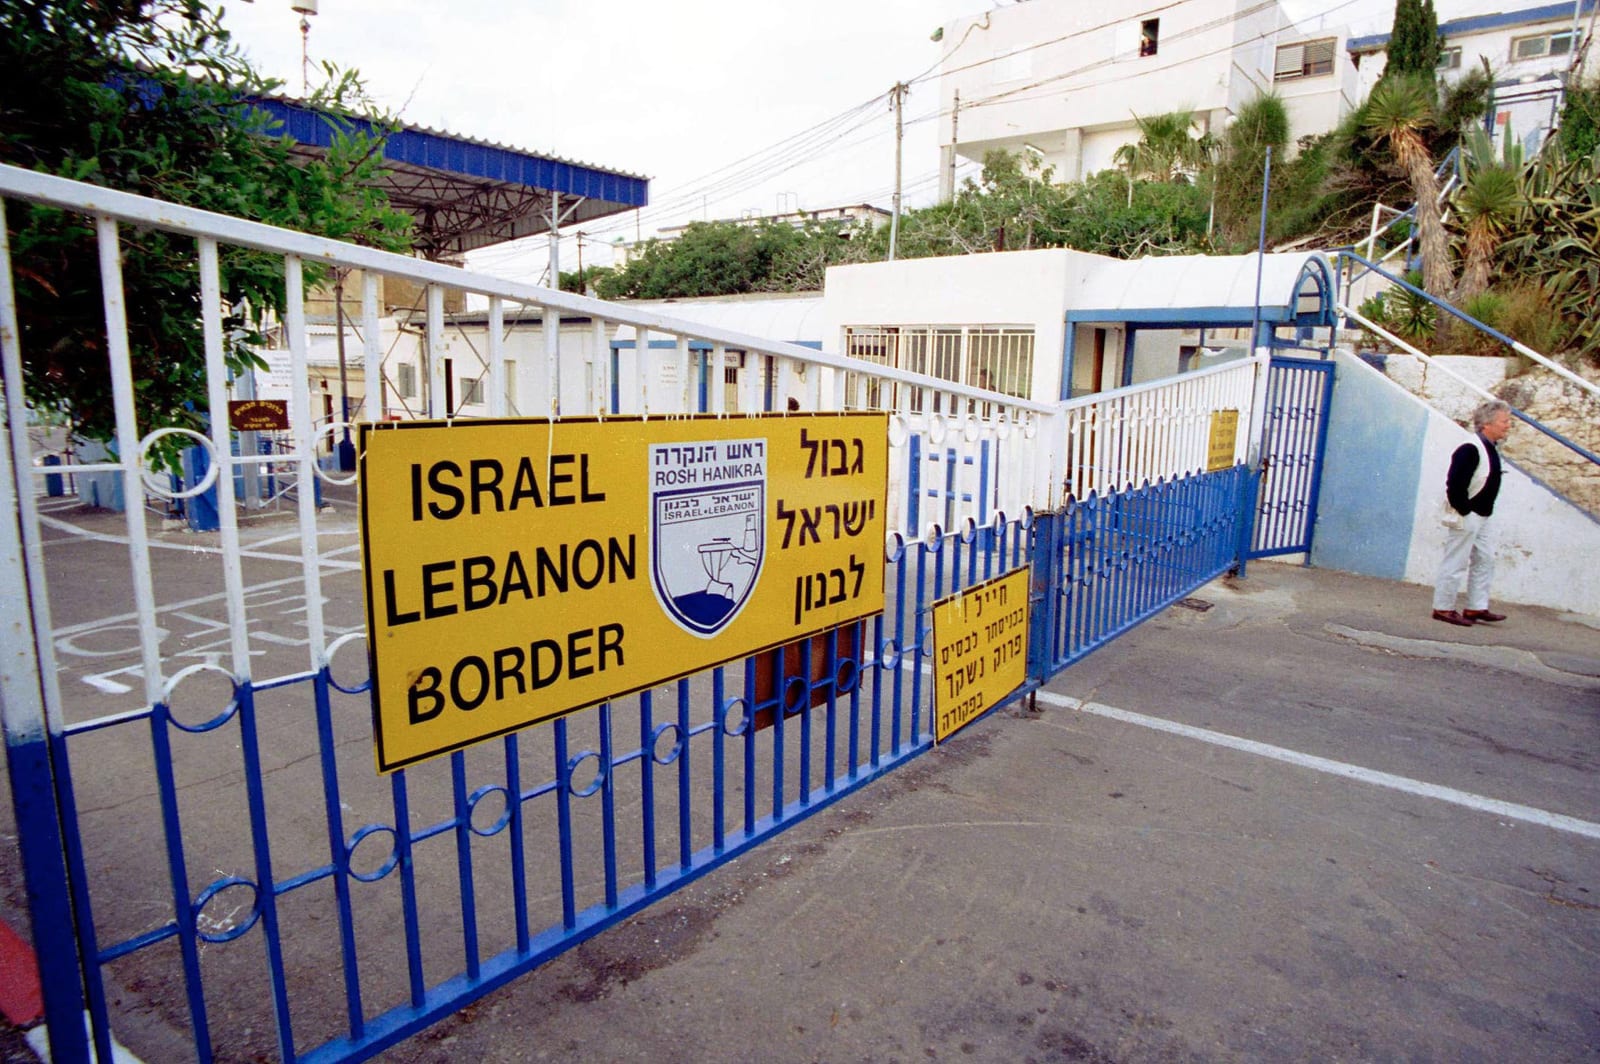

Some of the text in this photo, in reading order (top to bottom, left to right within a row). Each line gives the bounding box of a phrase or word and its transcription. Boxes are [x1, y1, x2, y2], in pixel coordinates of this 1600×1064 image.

[656, 442, 763, 467] ראש הנקרה
[656, 463, 762, 486] ROSH HANIKRA
[800, 428, 864, 479] גבול
[412, 454, 605, 521] ISRAEL
[665, 492, 755, 512] ישראל לבנון
[777, 499, 875, 549] ישראל
[384, 534, 636, 626] LEBANON
[795, 554, 864, 625] לבנון
[941, 607, 1024, 665] בכניסתך לבסיס
[407, 622, 625, 725] BORDER
[945, 633, 1022, 698] פרוק נשקך
[942, 691, 983, 731] בפקודה
